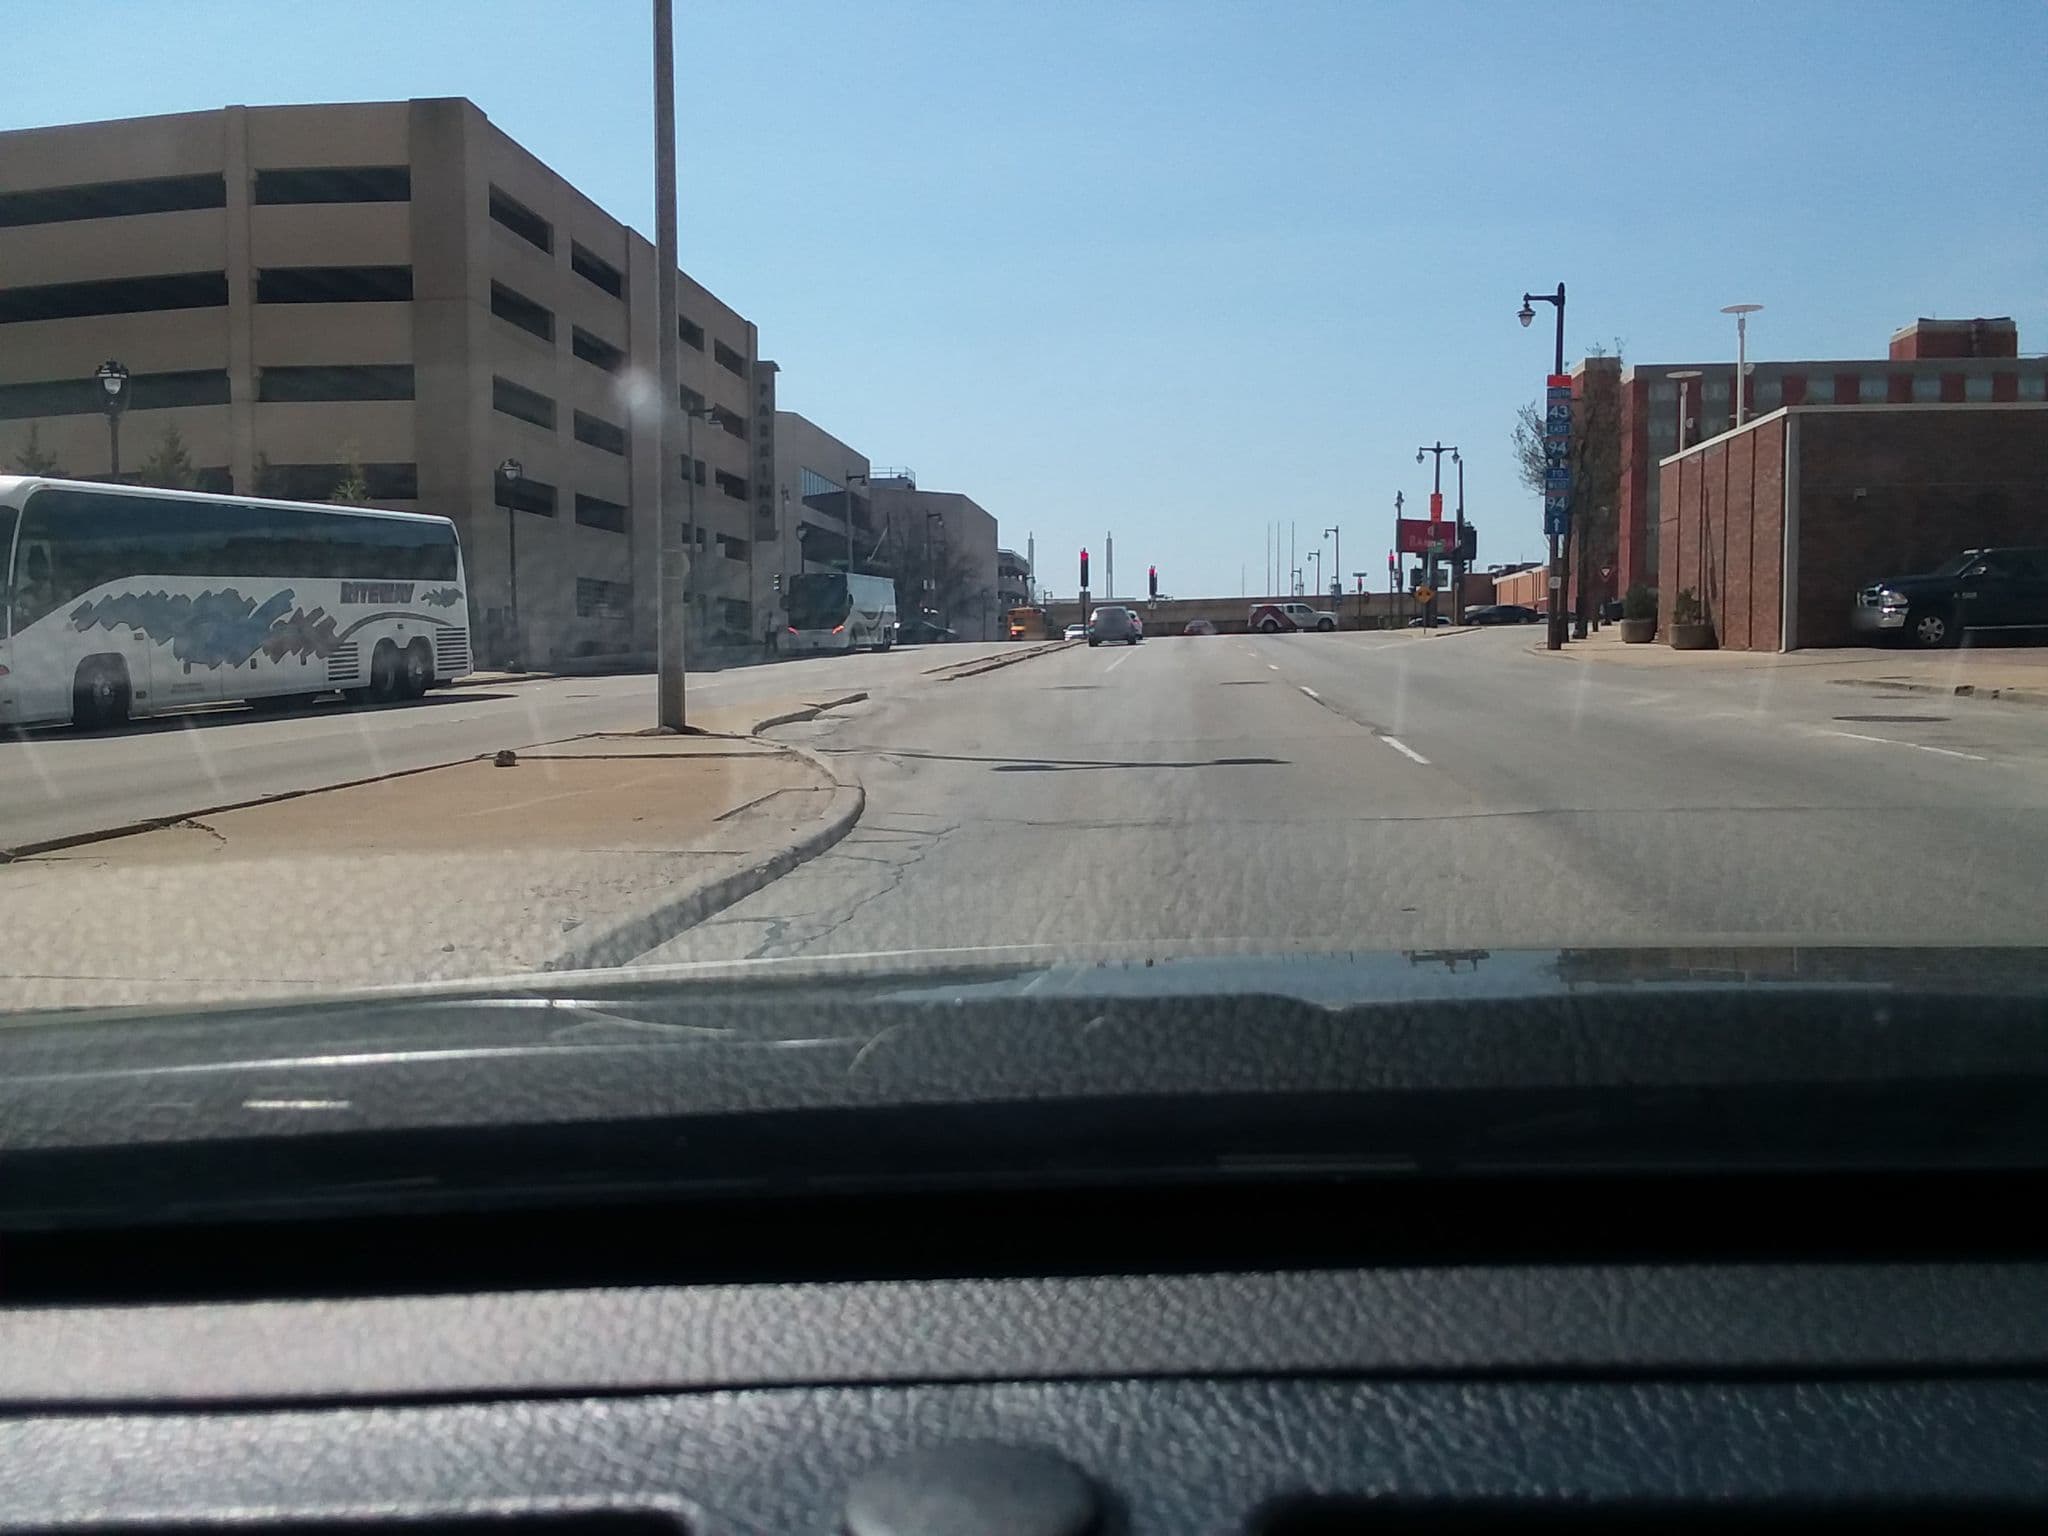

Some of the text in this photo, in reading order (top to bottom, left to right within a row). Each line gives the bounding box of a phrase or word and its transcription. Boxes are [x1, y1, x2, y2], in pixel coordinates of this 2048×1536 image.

[1549, 405, 1569, 418] 43
[1549, 425, 1567, 433] EAST
[759, 383, 772, 518] PARKING
[1548, 441, 1567, 453] 94
[1552, 469, 1564, 477] TO
[1546, 496, 1566, 509] 94
